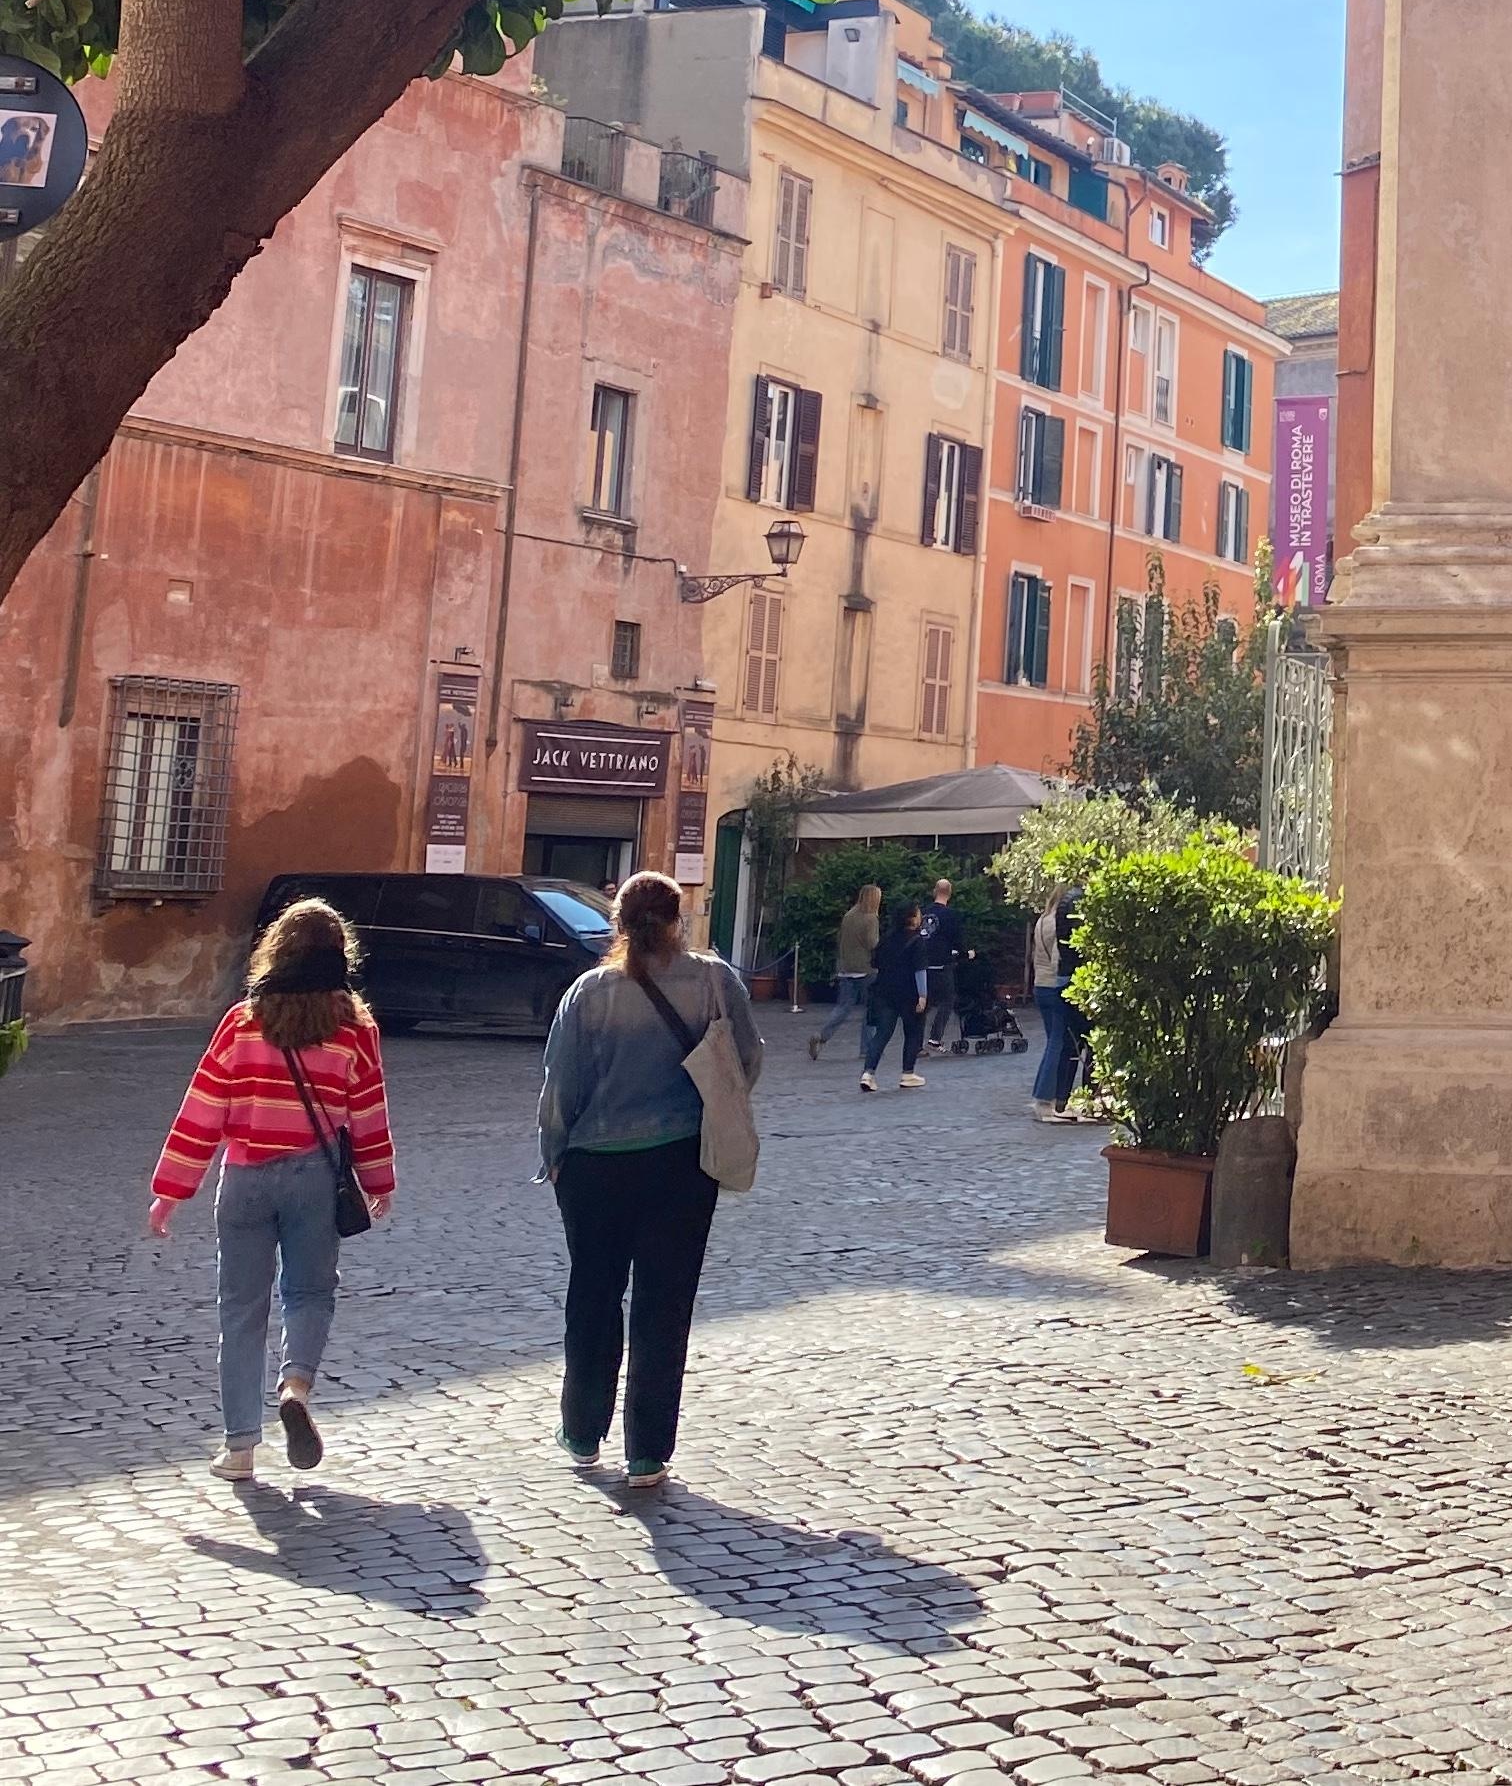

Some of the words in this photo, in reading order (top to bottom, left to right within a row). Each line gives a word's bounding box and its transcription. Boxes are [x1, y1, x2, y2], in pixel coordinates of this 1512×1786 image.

[1291, 424, 1303, 470] ROMA
[1290, 474, 1301, 489] DI
[1301, 434, 1314, 528] TRASTEVERE
[1289, 493, 1301, 546] MUSEO
[1300, 531, 1311, 546] IN
[1314, 554, 1326, 594] ROMA
[533, 748, 571, 766] JACK
[580, 751, 659, 771] VETTRIANO
